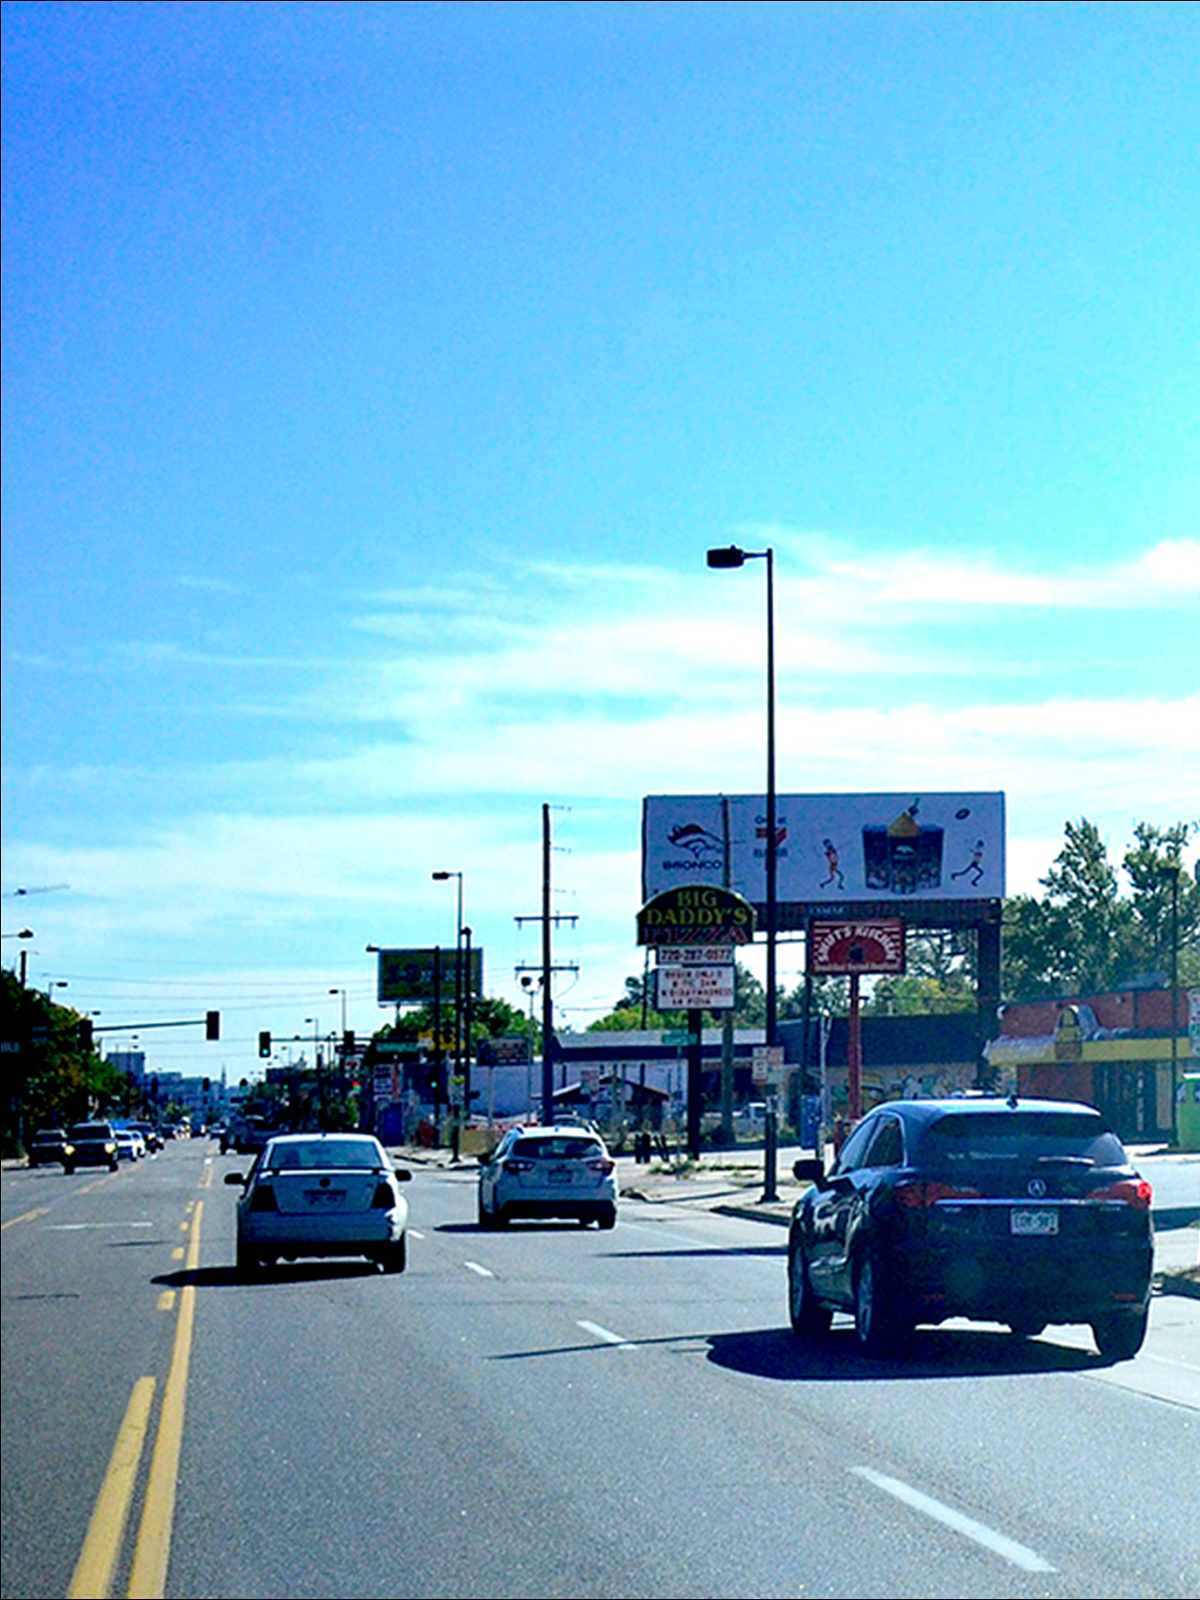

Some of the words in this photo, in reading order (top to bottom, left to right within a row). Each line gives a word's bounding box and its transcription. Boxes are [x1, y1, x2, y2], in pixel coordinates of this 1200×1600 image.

[663, 860, 723, 870] BRONCO
[677, 890, 718, 907] BIG
[646, 908, 748, 925] DADDY'S
